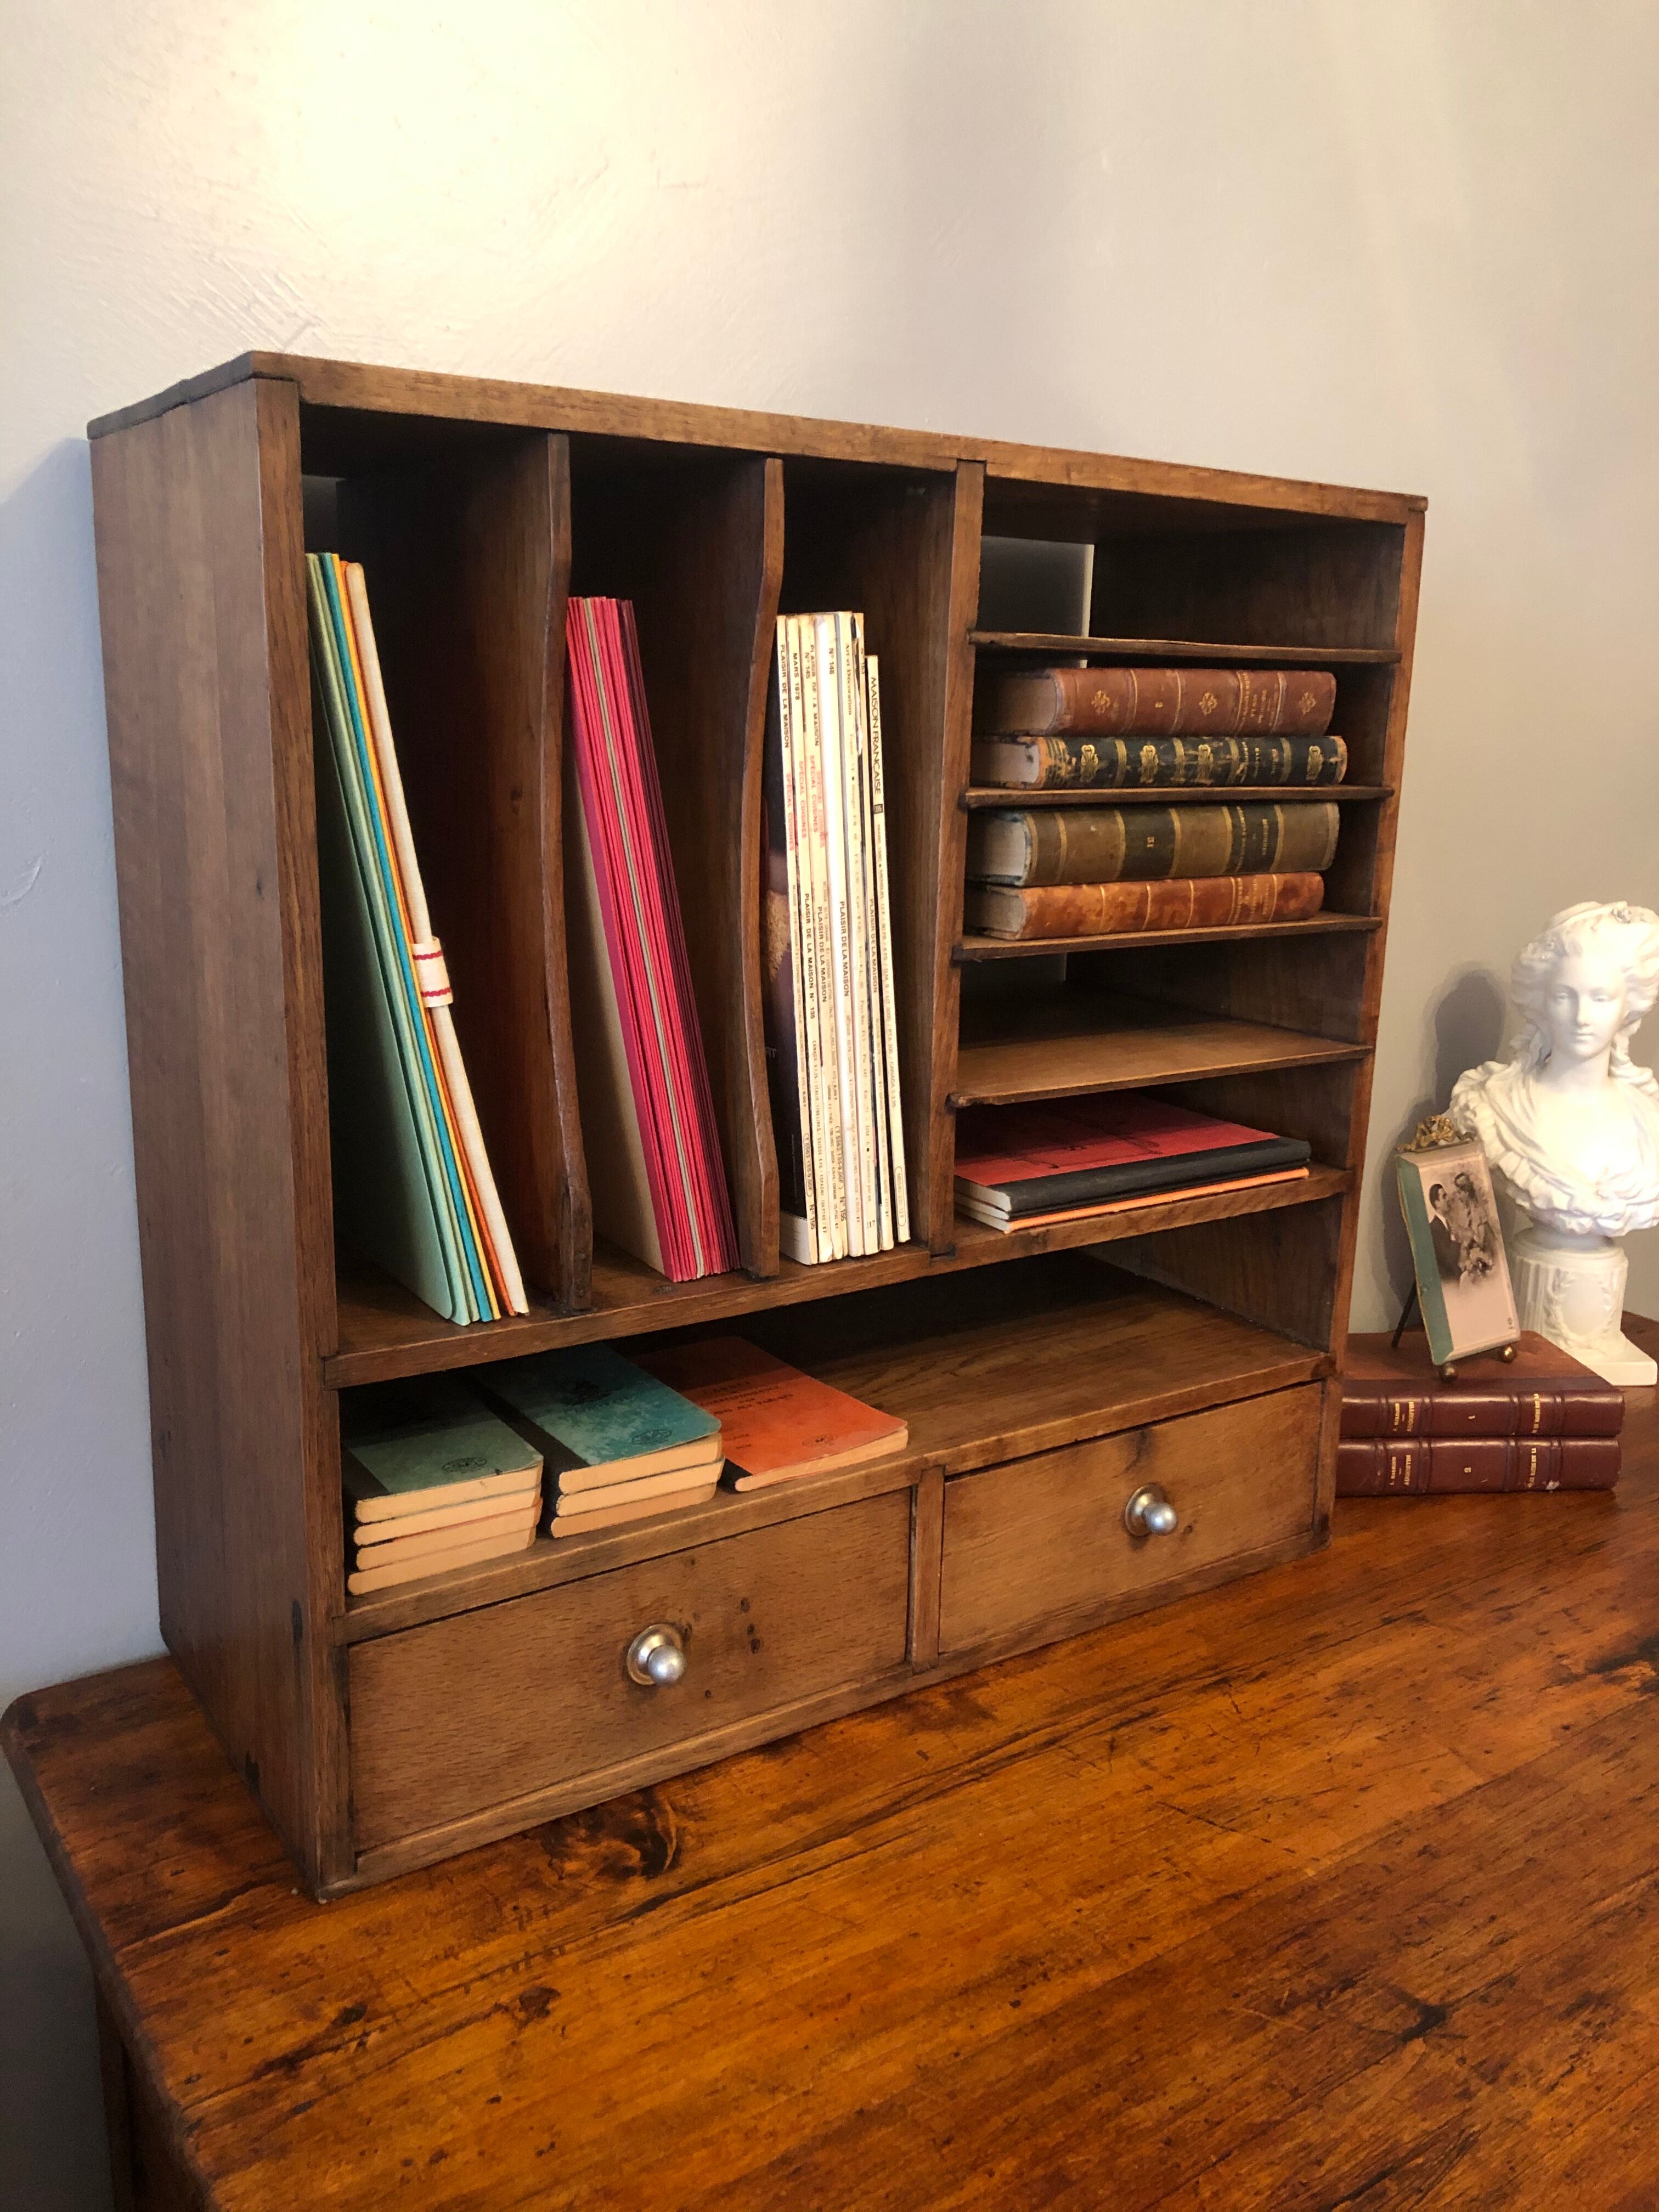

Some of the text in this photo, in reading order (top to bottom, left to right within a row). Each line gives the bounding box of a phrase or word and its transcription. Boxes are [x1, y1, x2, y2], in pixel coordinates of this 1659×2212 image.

[782, 682, 787, 694] DE
[783, 698, 788, 709] LA
[871, 676, 879, 728] MAISON
[806, 928, 812, 939] DE
[871, 933, 876, 945] DE
[819, 941, 825, 953] DE
[841, 936, 847, 947] DE
[807, 943, 812, 954] LA
[871, 946, 877, 957] LA
[842, 949, 848, 960] LA
[820, 955, 825, 966] LA
